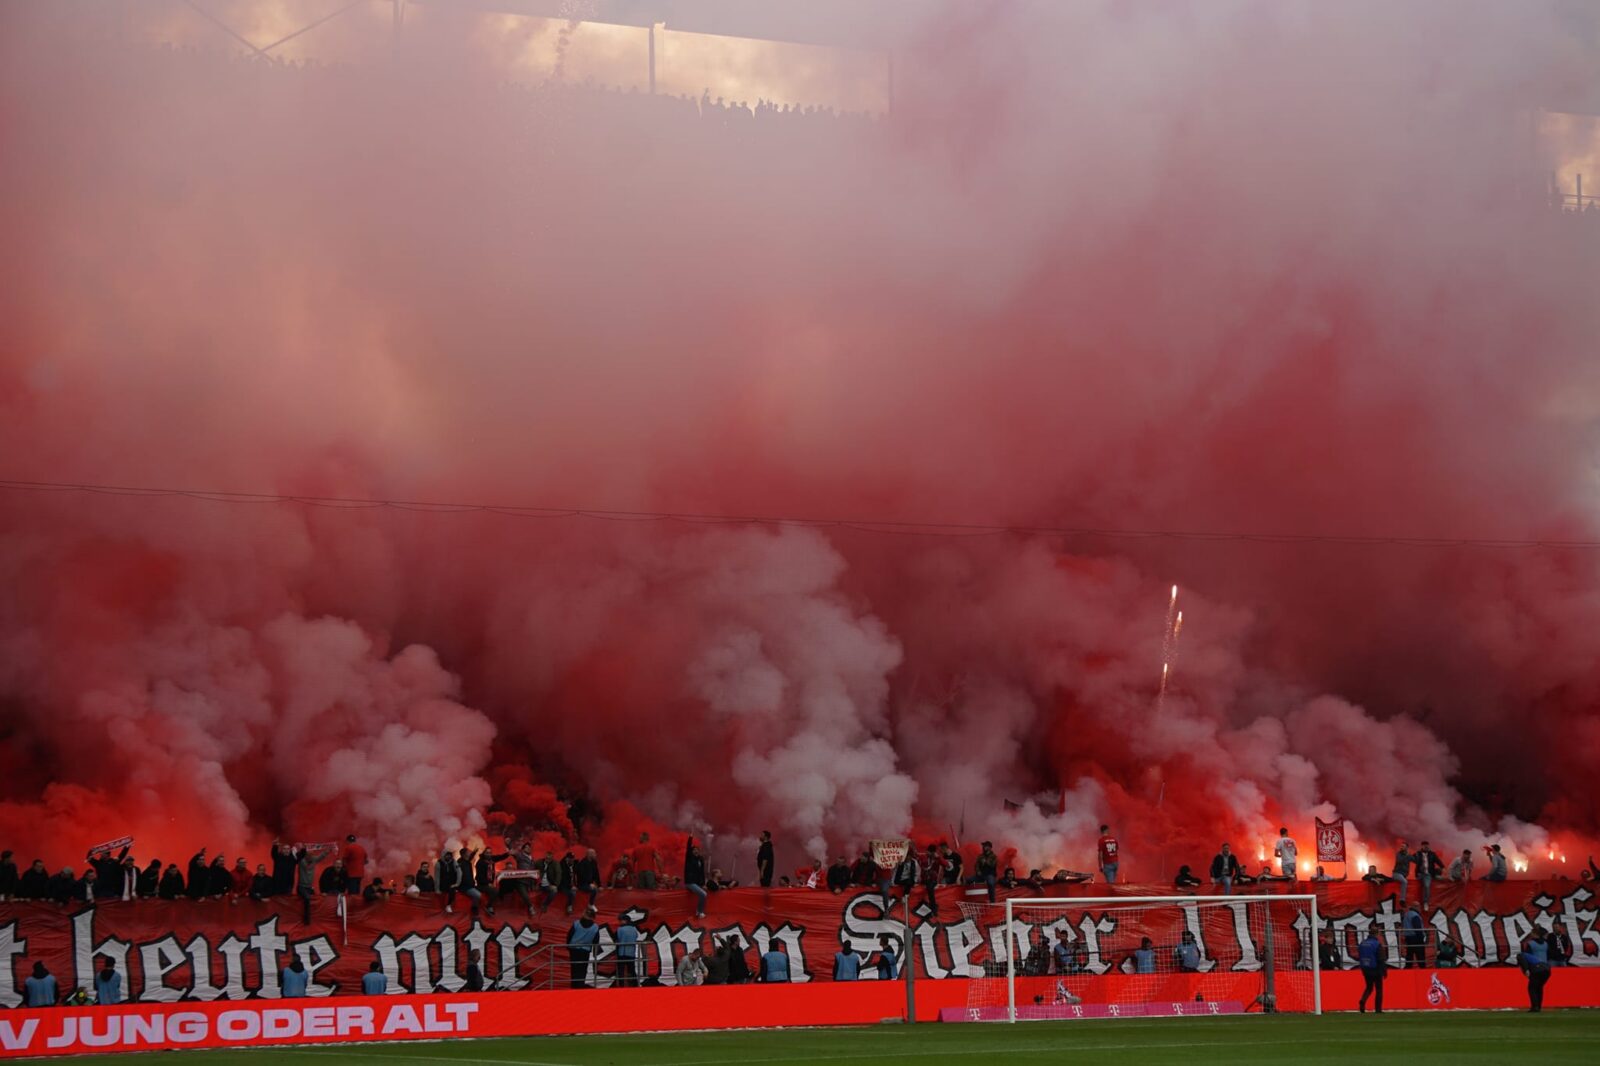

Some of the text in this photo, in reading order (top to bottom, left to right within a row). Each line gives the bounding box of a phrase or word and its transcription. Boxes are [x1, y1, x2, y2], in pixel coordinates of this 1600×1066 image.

[68, 906, 338, 1002] heute
[1292, 899, 1407, 971] rot
[47, 1012, 209, 1048] JUNG
[217, 1006, 374, 1040] ODER
[382, 1003, 479, 1034] ALT
